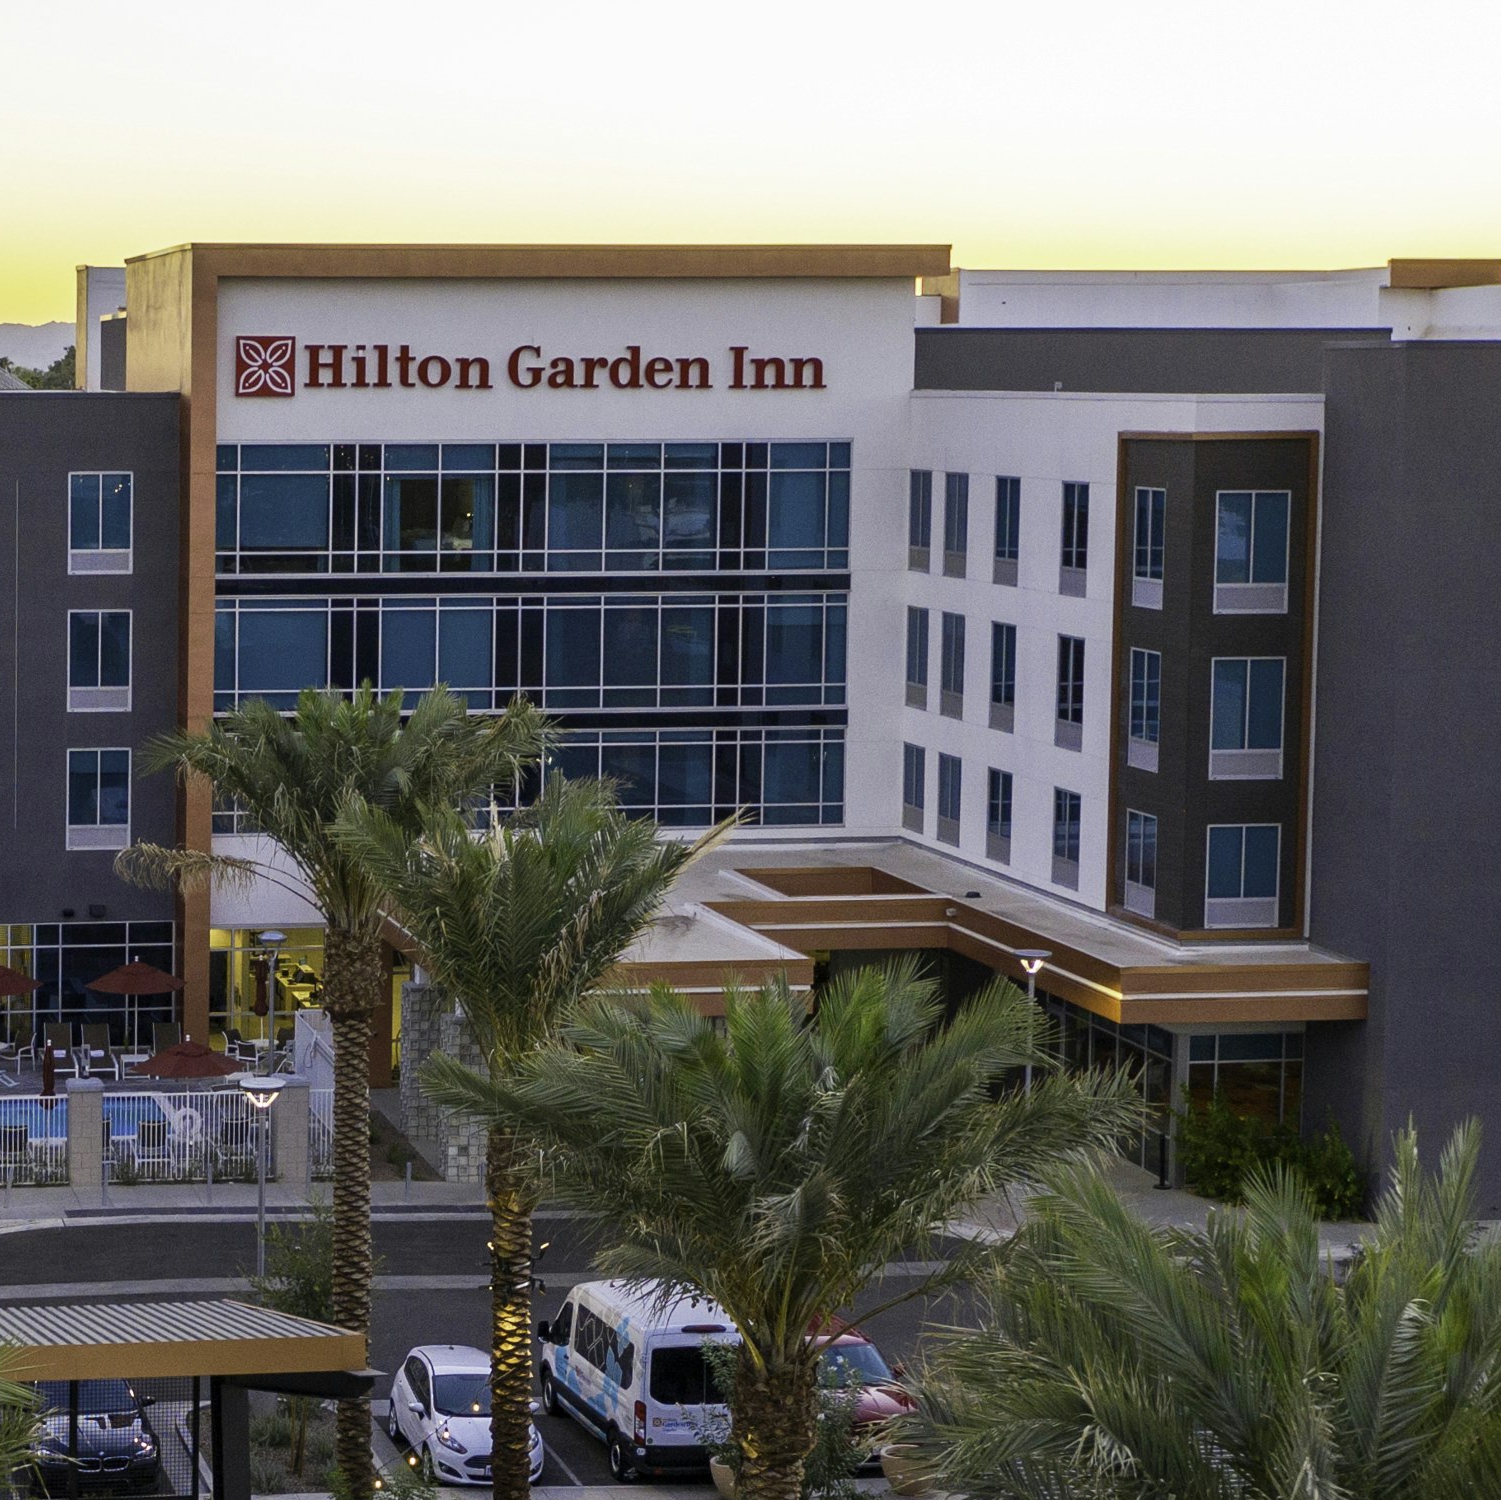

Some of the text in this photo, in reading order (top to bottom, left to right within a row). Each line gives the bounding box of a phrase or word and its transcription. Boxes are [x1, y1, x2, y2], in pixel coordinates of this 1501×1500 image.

[303, 344, 827, 389] Hilton Garden Inn
